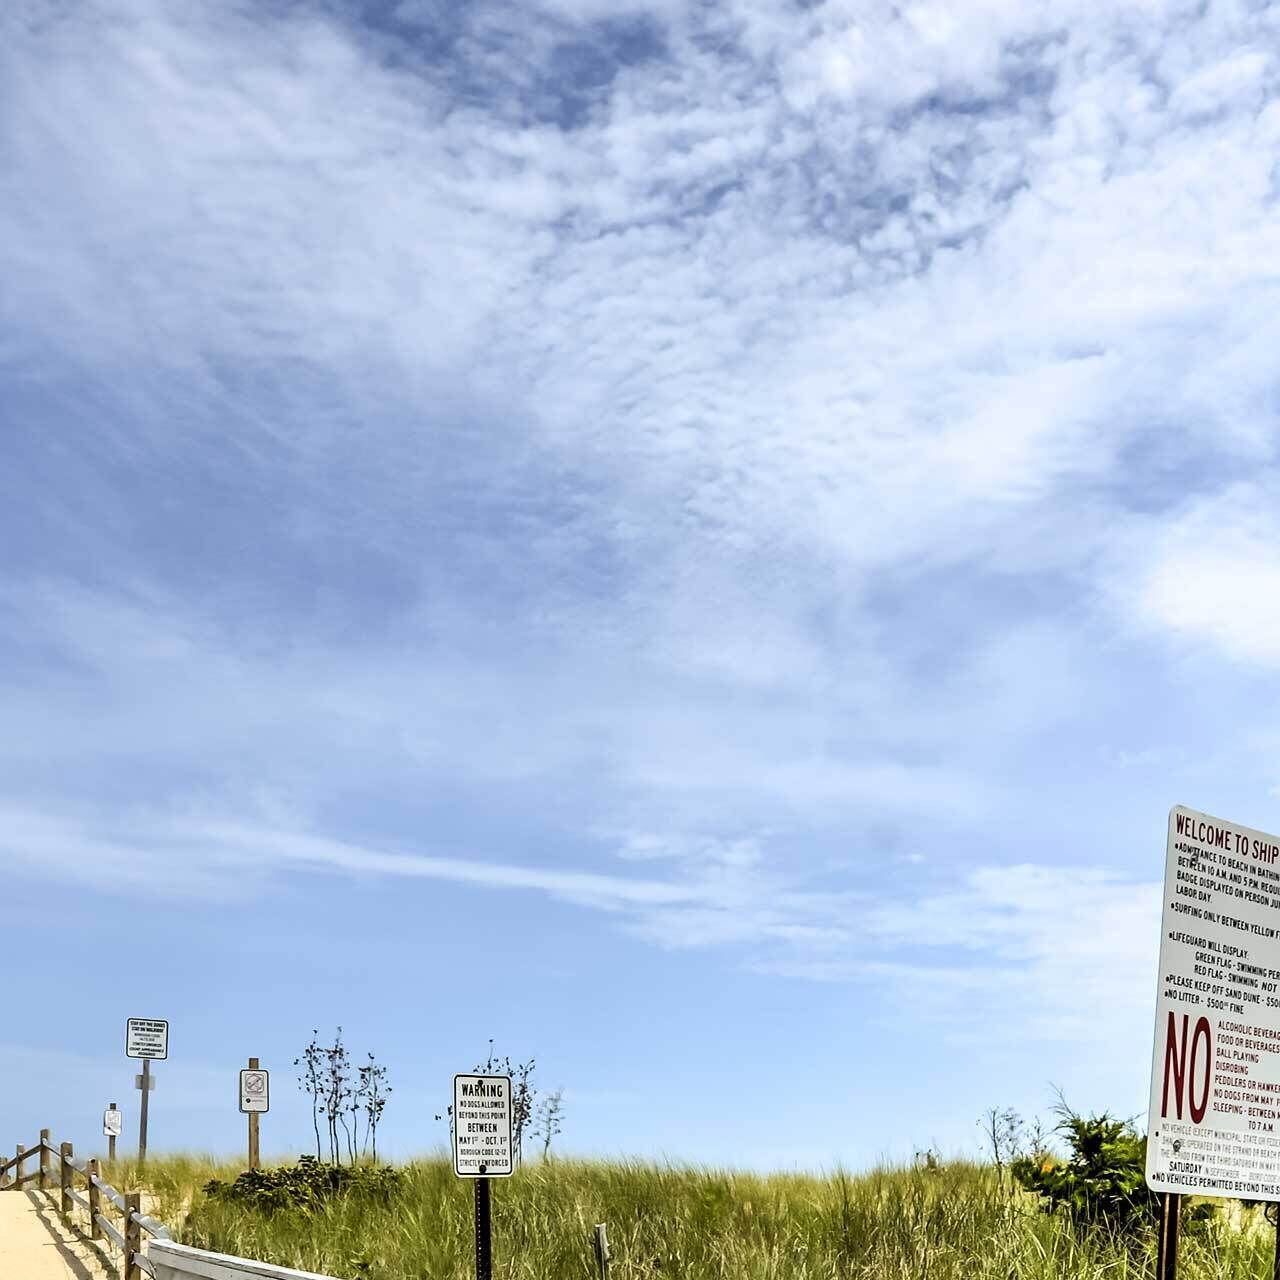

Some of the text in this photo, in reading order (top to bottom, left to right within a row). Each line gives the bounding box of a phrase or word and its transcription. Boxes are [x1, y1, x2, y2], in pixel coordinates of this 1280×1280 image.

[1176, 814, 1231, 850] WELCOME
[1235, 834, 1249, 855] TO
[1252, 840, 1279, 864] SHIP
[1219, 855, 1226, 865] TO
[1228, 858, 1248, 872] BEACH
[1250, 865, 1256, 874] IN
[1208, 866, 1214, 875] 10
[1229, 873, 1242, 884] AND
[1243, 878, 1247, 886] 5
[1177, 870, 1198, 885] BADGE
[1200, 877, 1233, 896] DISPLAYED
[1235, 888, 1243, 898] ON
[1245, 890, 1269, 906] PERSON
[1175, 902, 1202, 919] SURFING
[1204, 910, 1221, 923] ONLY
[1222, 915, 1249, 931] BETWEEN
[1250, 924, 1274, 937] YELLOW
[1172, 931, 1206, 948] LIFEGUARD
[1208, 941, 1221, 952] WILL
[1195, 951, 1215, 964] GREEN
[1217, 957, 1232, 969] FLAG
[1237, 962, 1267, 978] SWIMMING
[1194, 965, 1206, 975] RED
[1208, 968, 1223, 980] FLAG
[1228, 973, 1258, 988] SWIMMING
[1262, 982, 1277, 992] NOT
[1170, 974, 1193, 989] PLEASE
[1194, 981, 1210, 993] KEEP
[1212, 985, 1224, 995] OFF
[1226, 988, 1242, 1000] SAND
[1243, 992, 1260, 1003] DUNE
[1168, 990, 1177, 999] NO
[1179, 992, 1199, 1004] LITTER
[1230, 1003, 1244, 1014] FINE
[1218, 1021, 1252, 1036] ALCOHOLIC
[1218, 1034, 1280, 1053] FOOD OR BEVERAGES
[1217, 1048, 1259, 1063] BALL PLAYING
[1161, 1011, 1212, 1124] NO
[1216, 1061, 1248, 1075] DISROBING
[462, 1084, 502, 1097] WARNING
[1215, 1075, 1247, 1089] PEDDLERS
[1248, 1080, 1255, 1088] OR
[1214, 1089, 1222, 1098] NO
[1224, 1091, 1240, 1101] DOGS
[1242, 1094, 1259, 1103] FROM
[1261, 1096, 1272, 1105] MAY
[1213, 1103, 1243, 1115] SLEEPING
[1248, 1108, 1275, 1119] BETWEEN
[468, 1123, 497, 1132] BETWEEN
[1249, 1121, 1256, 1130] TO
[1258, 1122, 1262, 1130] 7
[1169, 1161, 1202, 1174] SATURDAY
[1156, 1173, 1165, 1182] NO
[1167, 1174, 1197, 1186] VEHICLES
[1199, 1179, 1233, 1190] PERMITTED
[1235, 1182, 1259, 1194] BEYOND
[1261, 1184, 1274, 1195] THIS
